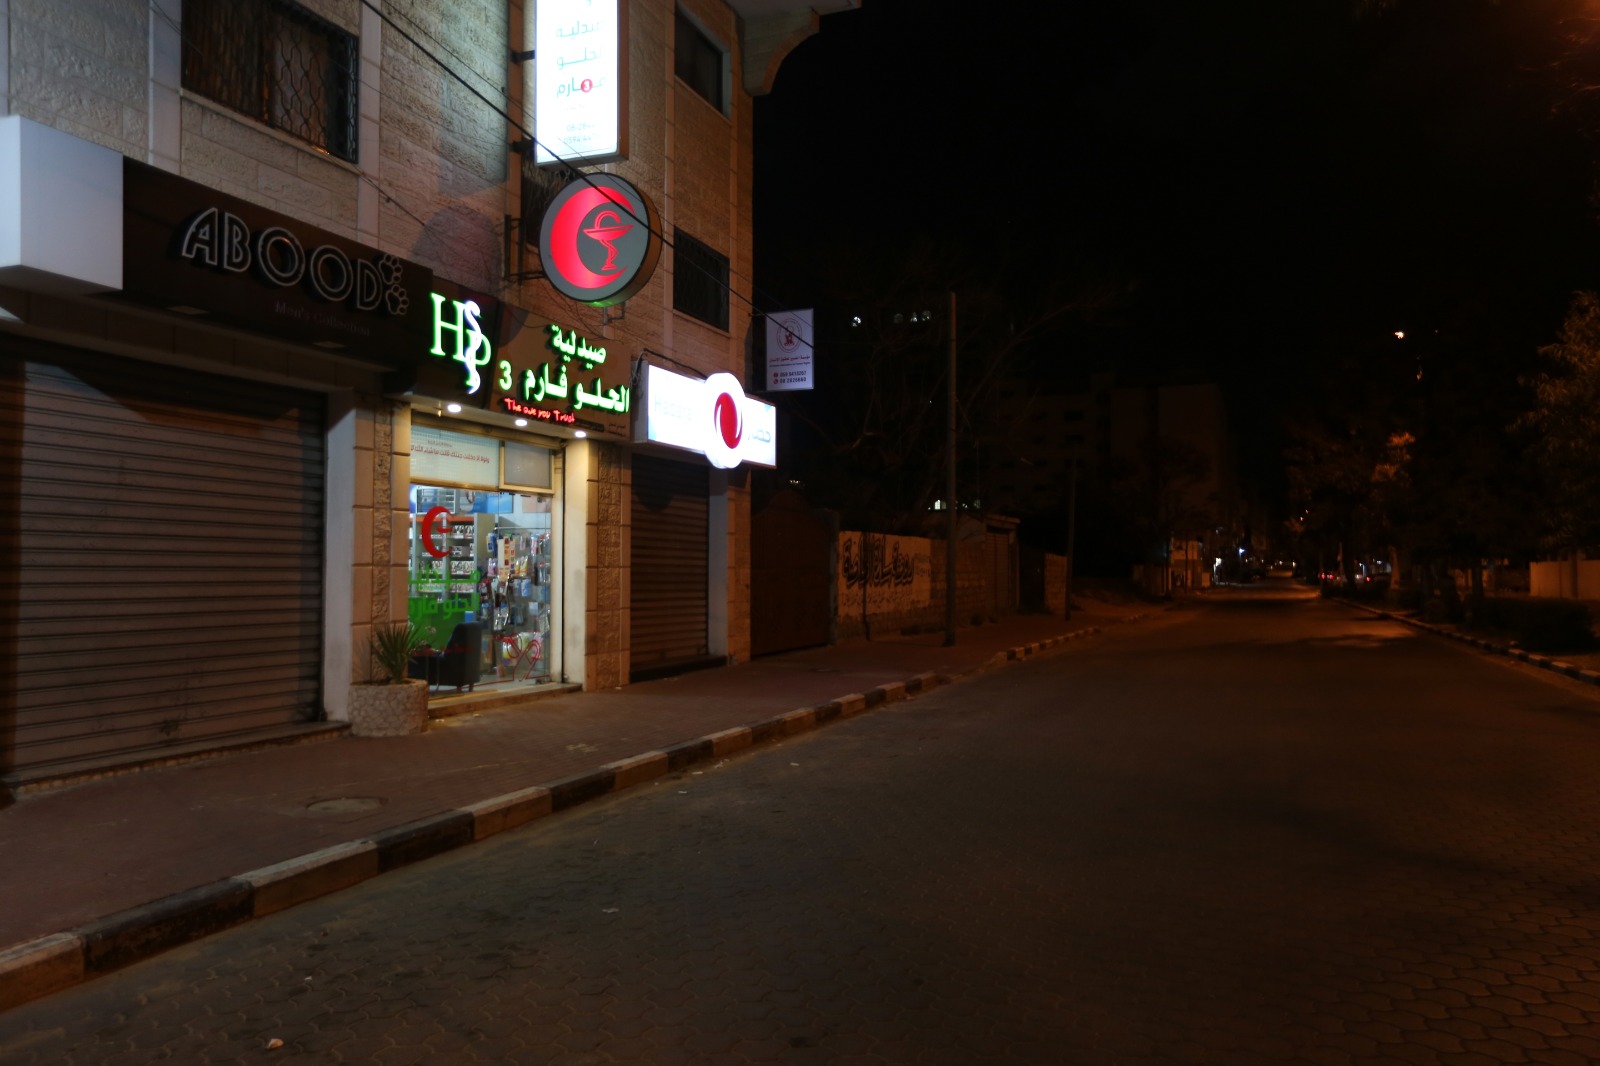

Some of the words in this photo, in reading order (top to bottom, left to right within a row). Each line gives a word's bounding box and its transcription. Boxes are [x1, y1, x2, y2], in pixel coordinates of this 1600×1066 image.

[181, 206, 383, 311] ABOOD
[313, 312, 370, 337] Collection
[550, 324, 608, 370] صيدلية
[498, 360, 513, 391] 3
[524, 363, 569, 402] فارم
[504, 397, 522, 412] The
[537, 409, 551, 419] you
[553, 409, 575, 423] Trust
[573, 378, 630, 414] الحلو
